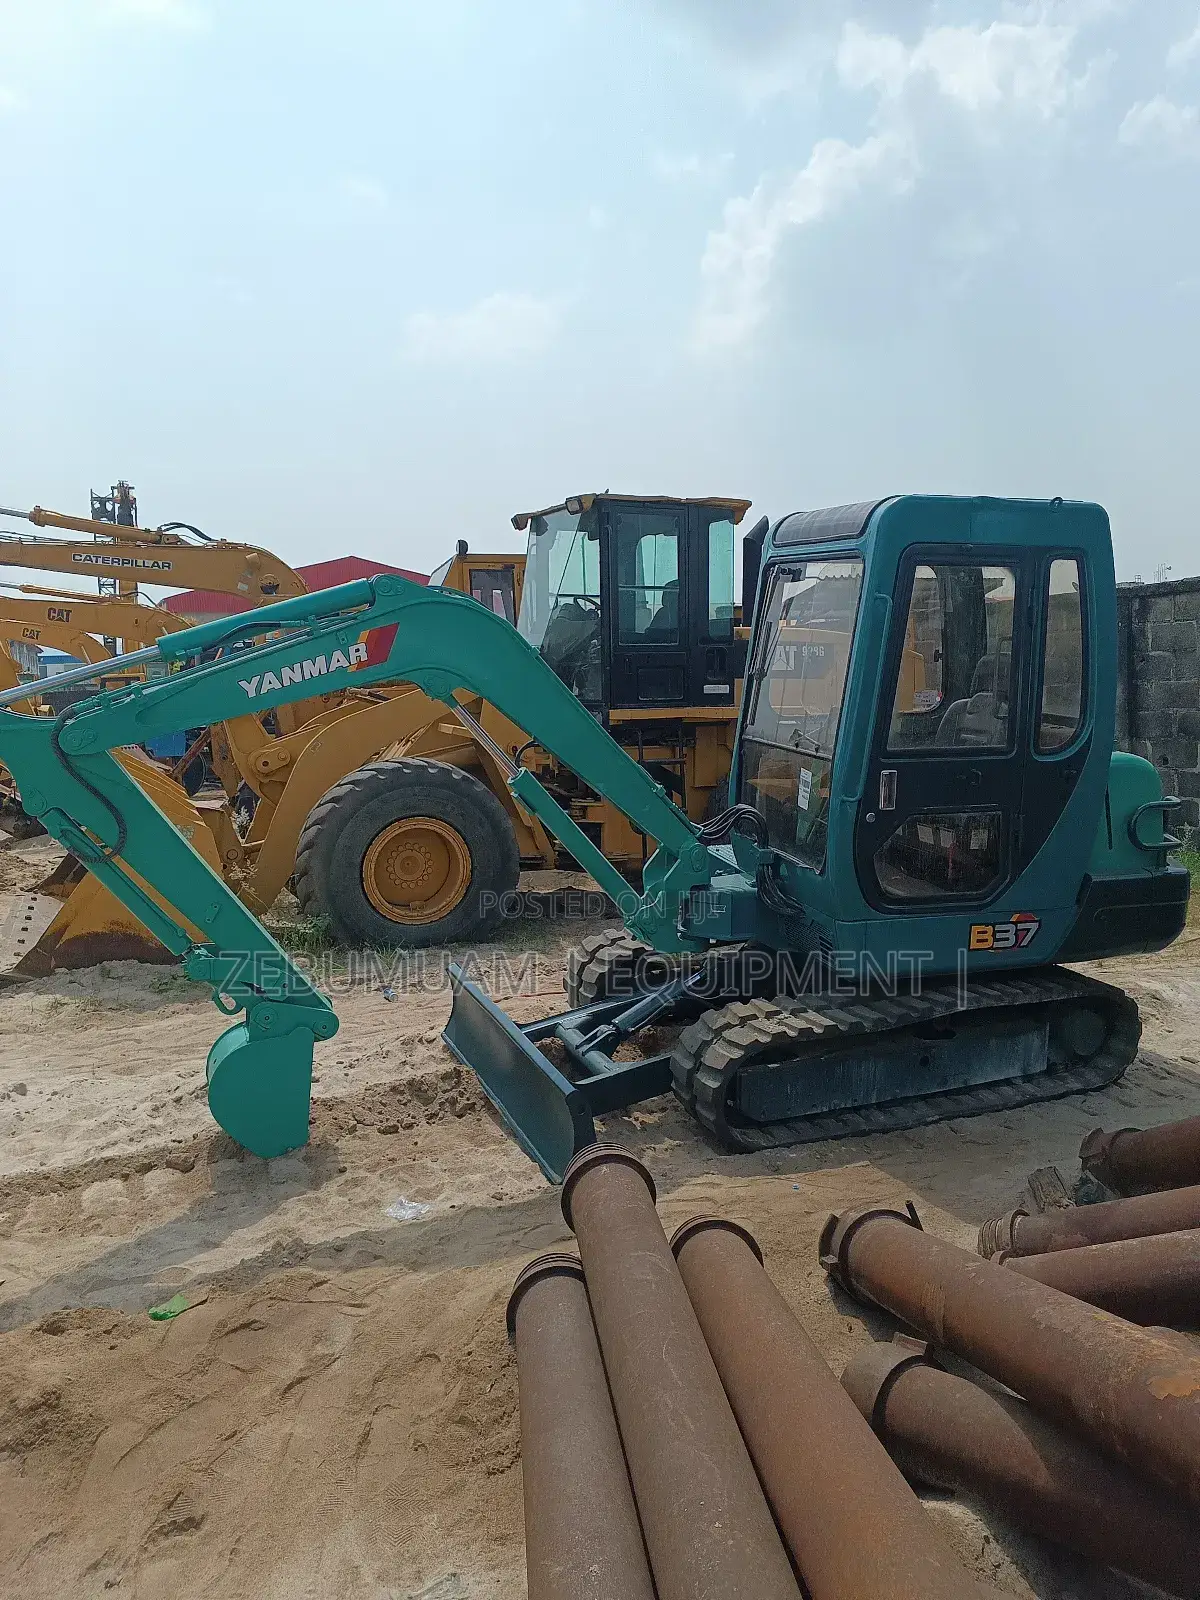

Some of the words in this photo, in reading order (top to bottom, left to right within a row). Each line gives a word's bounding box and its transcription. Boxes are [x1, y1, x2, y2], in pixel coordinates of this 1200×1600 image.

[72, 553, 172, 570] CATERPILLAR
[47, 607, 73, 623] CAT
[22, 627, 42, 640] CAT
[771, 645, 798, 671] AT
[237, 642, 368, 699] YANMAR
[969, 920, 1040, 950] B37
